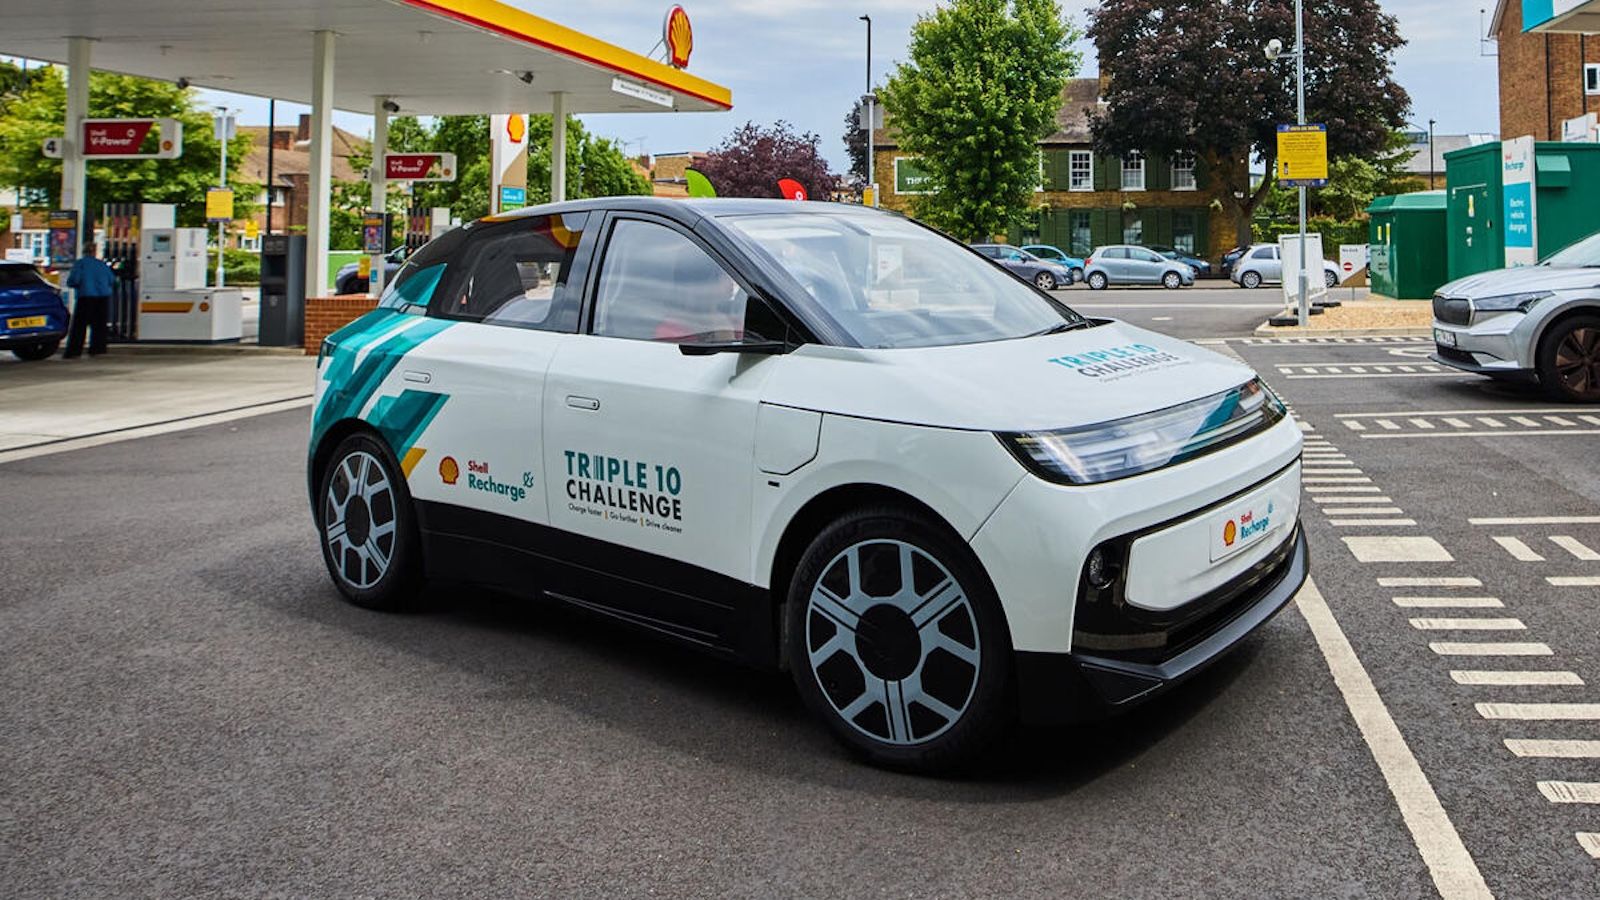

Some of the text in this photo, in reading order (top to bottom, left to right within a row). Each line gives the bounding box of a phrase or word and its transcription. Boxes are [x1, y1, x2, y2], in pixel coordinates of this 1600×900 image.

[46, 140, 56, 153] 4
[90, 136, 132, 147] V-Power
[1077, 352, 1180, 377] CHALLENGE
[467, 459, 489, 474] Shell
[467, 473, 526, 502] Recharge
[655, 464, 682, 496] 10
[566, 478, 683, 521] CHALLENGE
[568, 502, 587, 515] Charge
[619, 512, 638, 524] further
[645, 518, 660, 529] Drive
[661, 522, 682, 534] cleaner
[1240, 510, 1252, 525] Shell
[1241, 516, 1269, 540] Recharge
